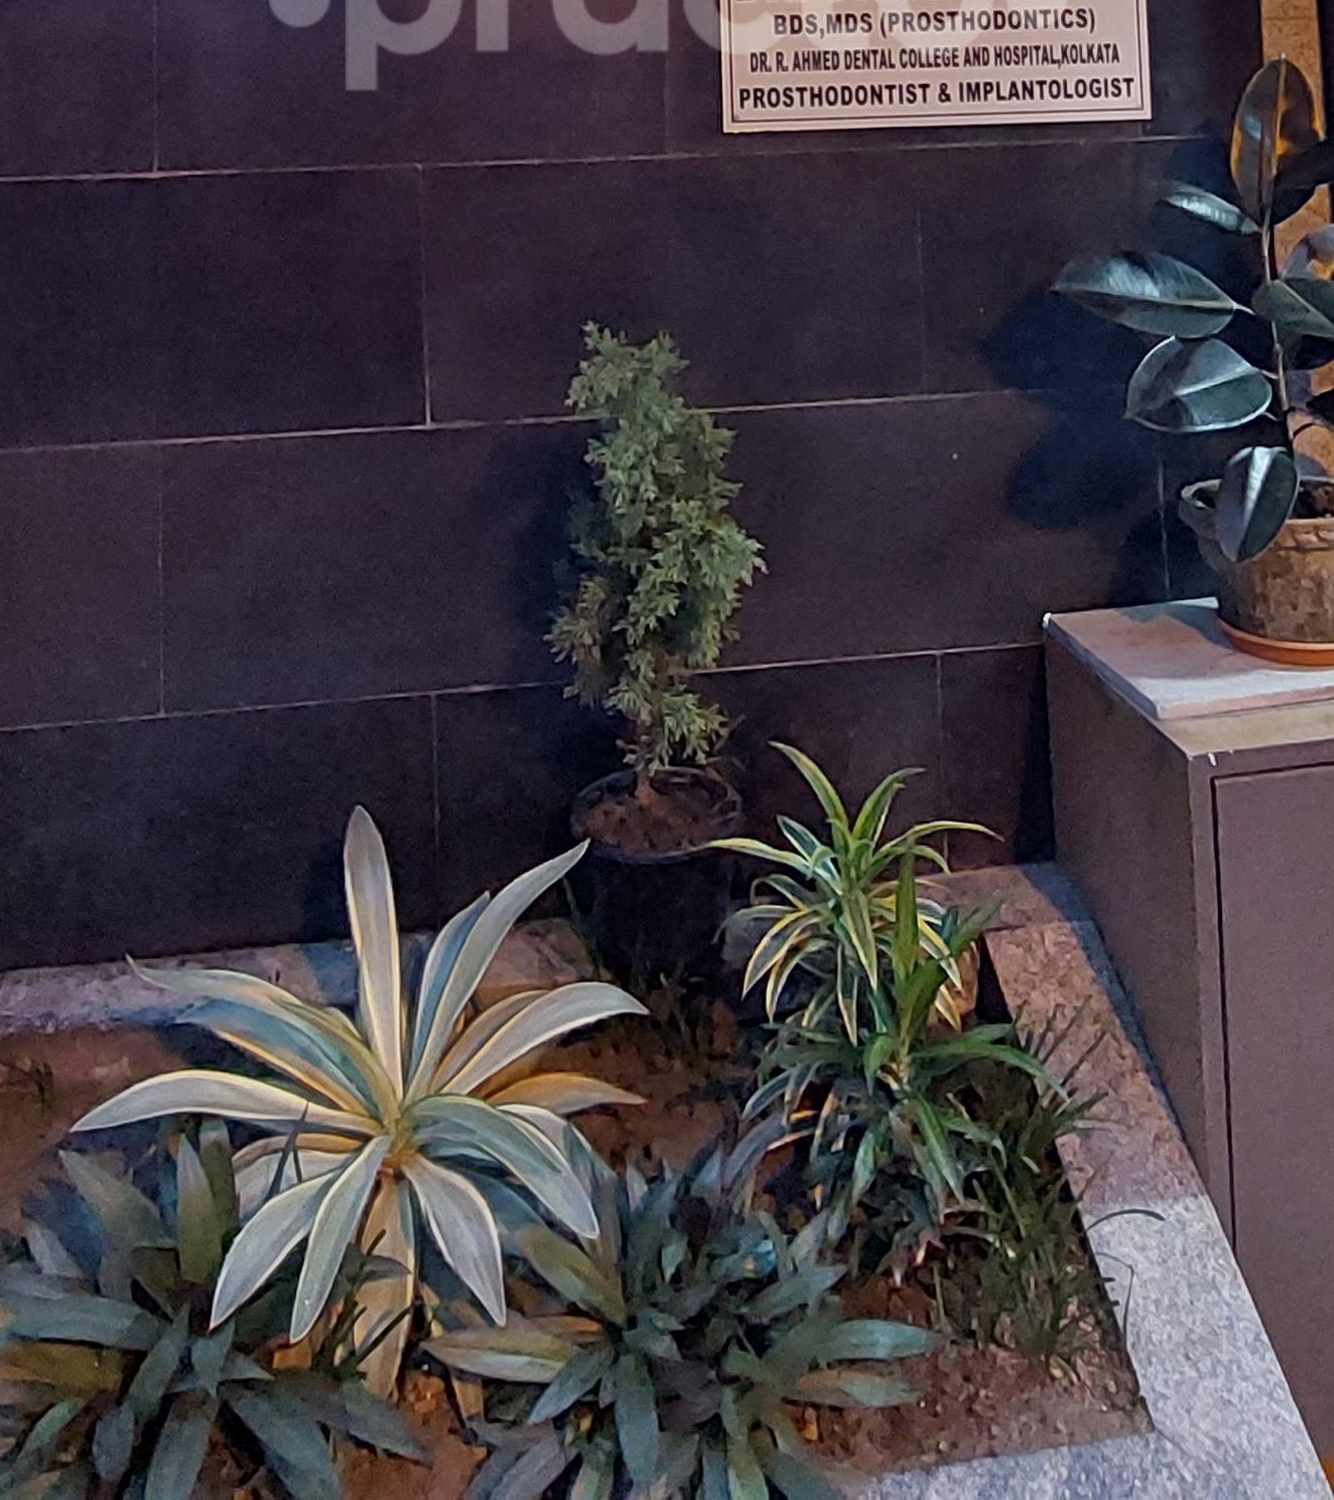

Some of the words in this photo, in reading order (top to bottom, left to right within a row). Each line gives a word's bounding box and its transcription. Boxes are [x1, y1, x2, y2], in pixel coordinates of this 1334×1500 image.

[773, 12, 873, 39] BDS,MDS
[879, 7, 1096, 39] (PROSTHODONTICS)
[750, 51, 773, 73] DR.
[775, 51, 789, 73] R.
[792, 49, 840, 72] AHMED
[844, 48, 896, 71] DENTAL
[899, 47, 960, 69] COLLEGE
[963, 46, 990, 67] AND
[993, 43, 1120, 69] HOSPITAL,KOLKATA
[739, 83, 931, 110] PROSTHODONTIST
[937, 82, 952, 103] &
[958, 77, 1135, 103] IMPLANTOLOGIST
